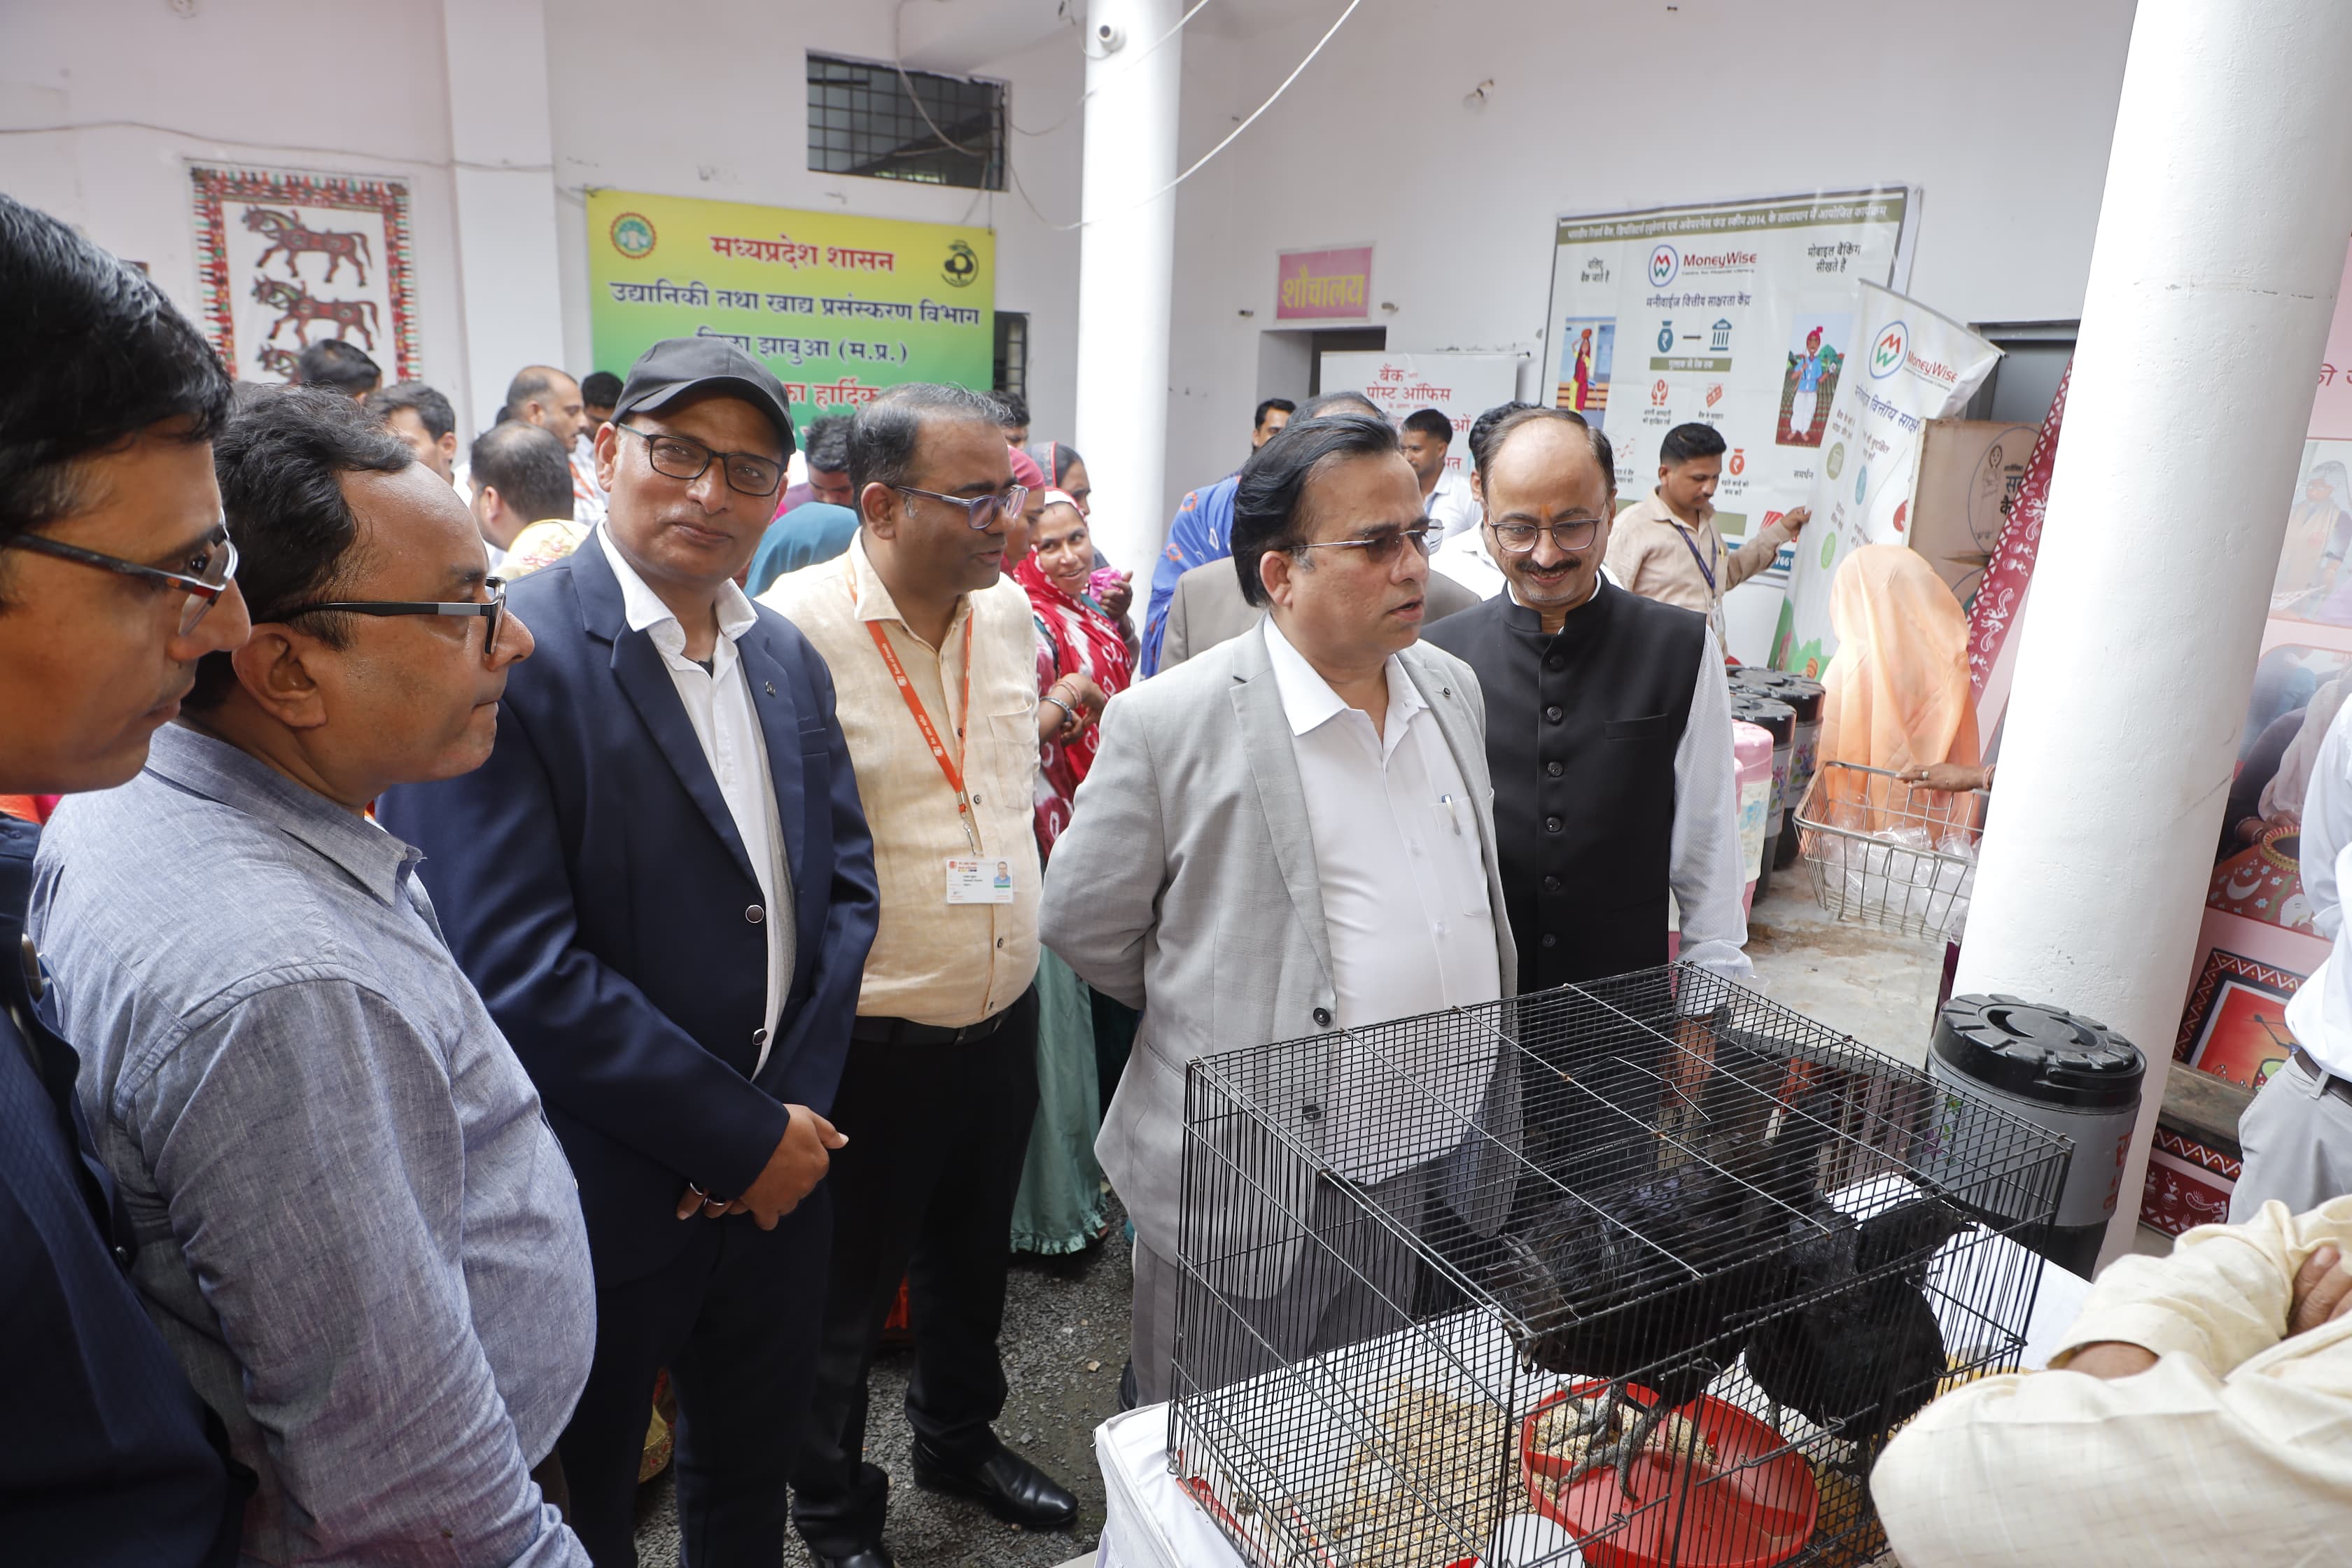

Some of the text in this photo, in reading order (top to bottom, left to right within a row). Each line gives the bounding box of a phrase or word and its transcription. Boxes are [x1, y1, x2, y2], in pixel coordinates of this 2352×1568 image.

[710, 234, 894, 272] मध्यप्रदेश शासन
[1684, 251, 1758, 269] MoneyWise
[609, 279, 979, 325] उद्यानिकी तथा खाद्य प्रसंस्करण विभाग
[1281, 265, 1366, 309] शौचालय
[758, 337, 830, 365] झाबुआ
[1906, 349, 1958, 384] MoneyWise
[1379, 363, 1404, 382] बैंक
[1366, 382, 1452, 402] पोस्ट ऑफिस
